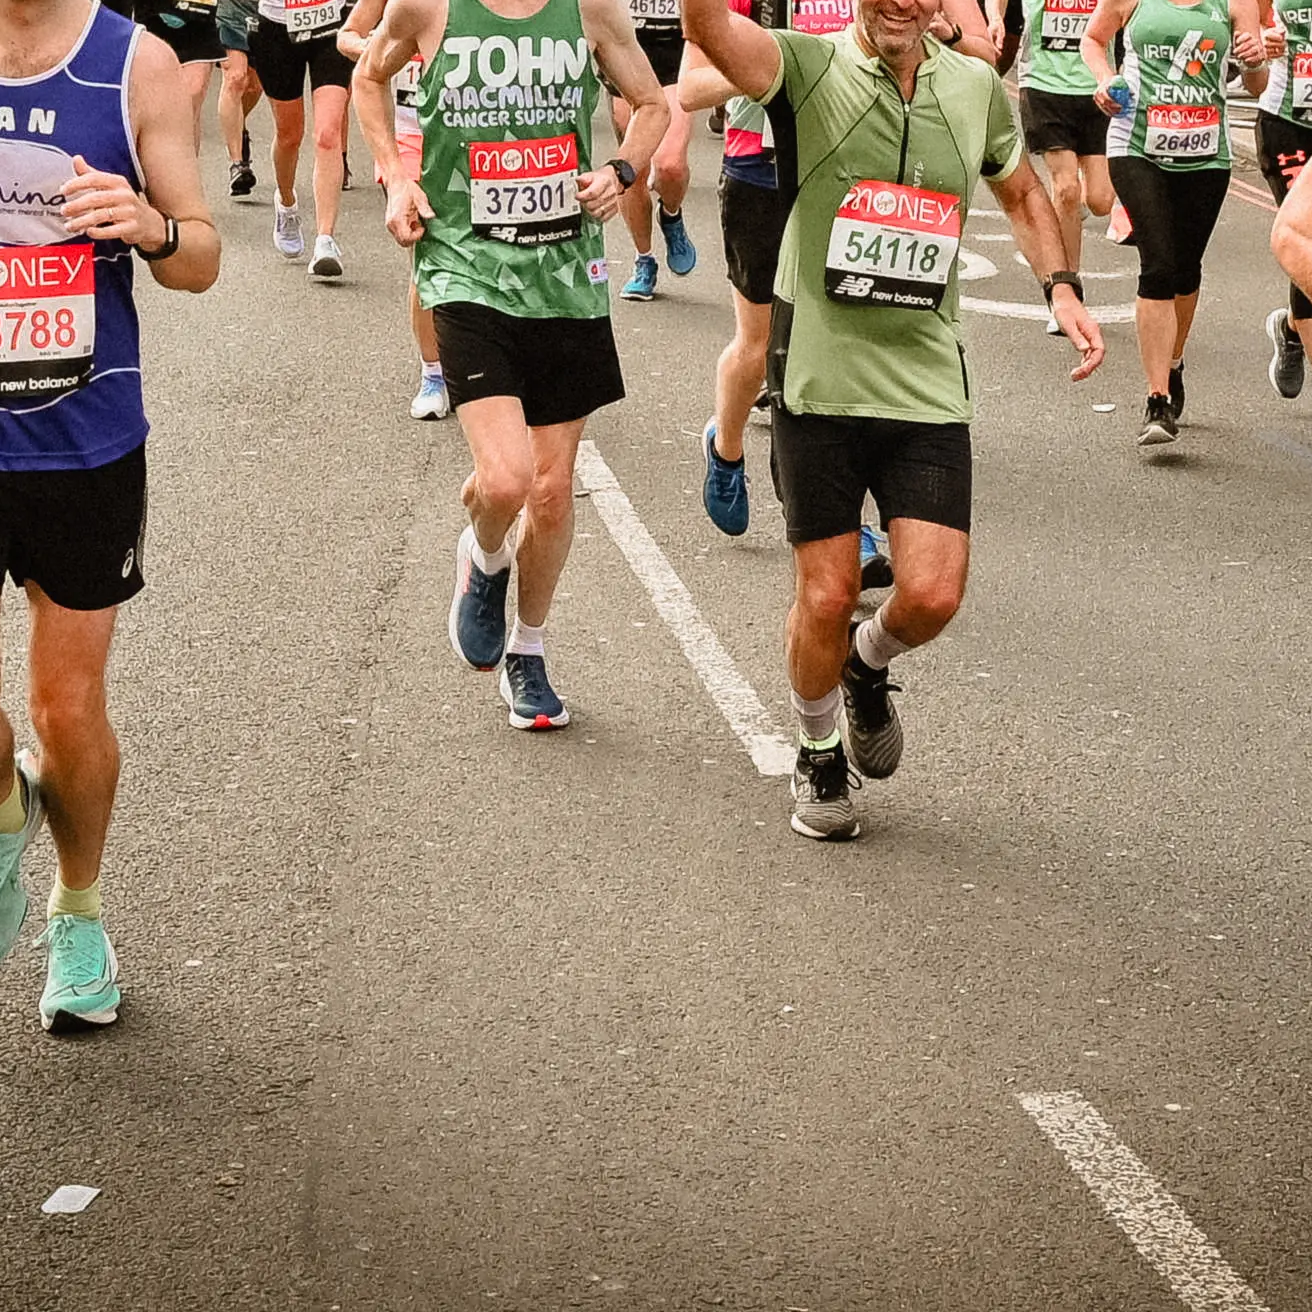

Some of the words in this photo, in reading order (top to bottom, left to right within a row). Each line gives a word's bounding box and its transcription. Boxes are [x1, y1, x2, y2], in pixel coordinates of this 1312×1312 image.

[293, 5, 335, 27] 55793
[1051, 17, 1089, 34] 1977
[442, 35, 588, 89] JOHN
[438, 85, 584, 111] MACMILLAN
[1150, 82, 1217, 105] JENNY
[442, 110, 511, 128] CANCER
[515, 107, 577, 126] SUPPOR
[1155, 131, 1211, 151] 26498
[474, 141, 571, 173] MONEY
[486, 181, 565, 216] 37301
[841, 186, 959, 226] MONEY
[844, 230, 940, 274] 54118
[0, 379, 27, 392] new
